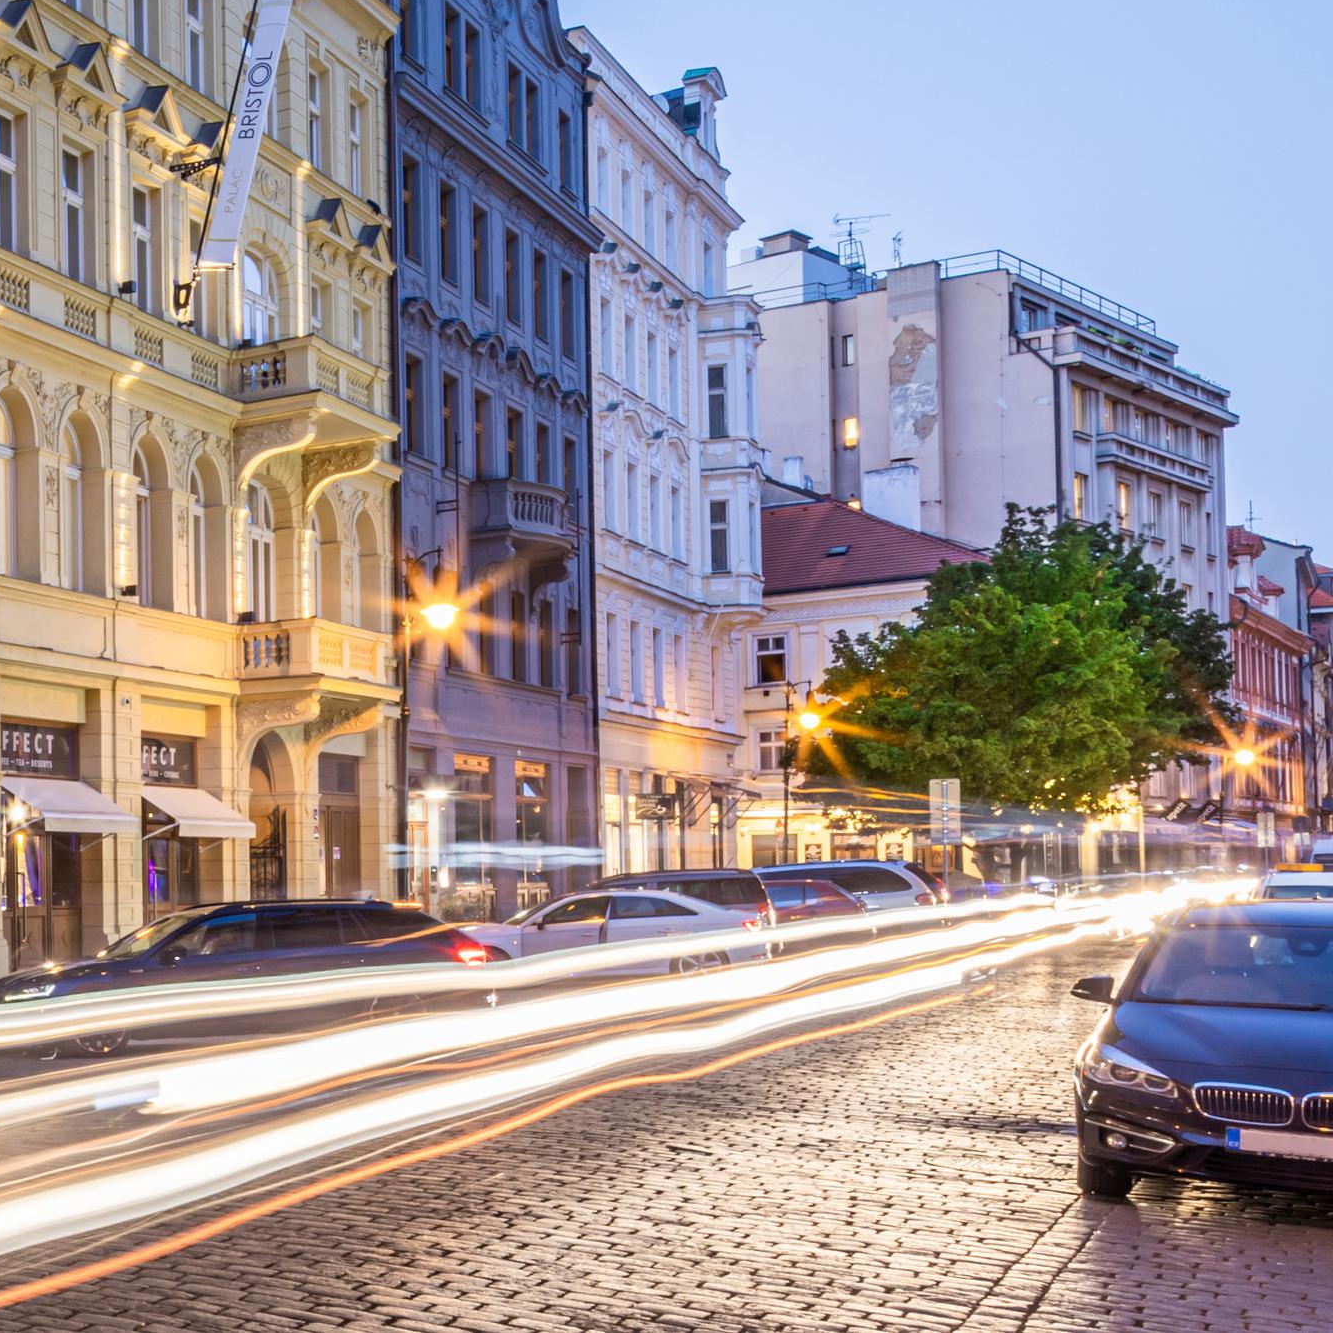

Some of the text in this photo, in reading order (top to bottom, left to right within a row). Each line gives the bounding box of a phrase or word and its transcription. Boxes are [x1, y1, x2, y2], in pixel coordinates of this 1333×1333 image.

[238, 50, 274, 140] BRISTOL
[2, 730, 55, 755] FFECT
[143, 745, 176, 766] FECT
